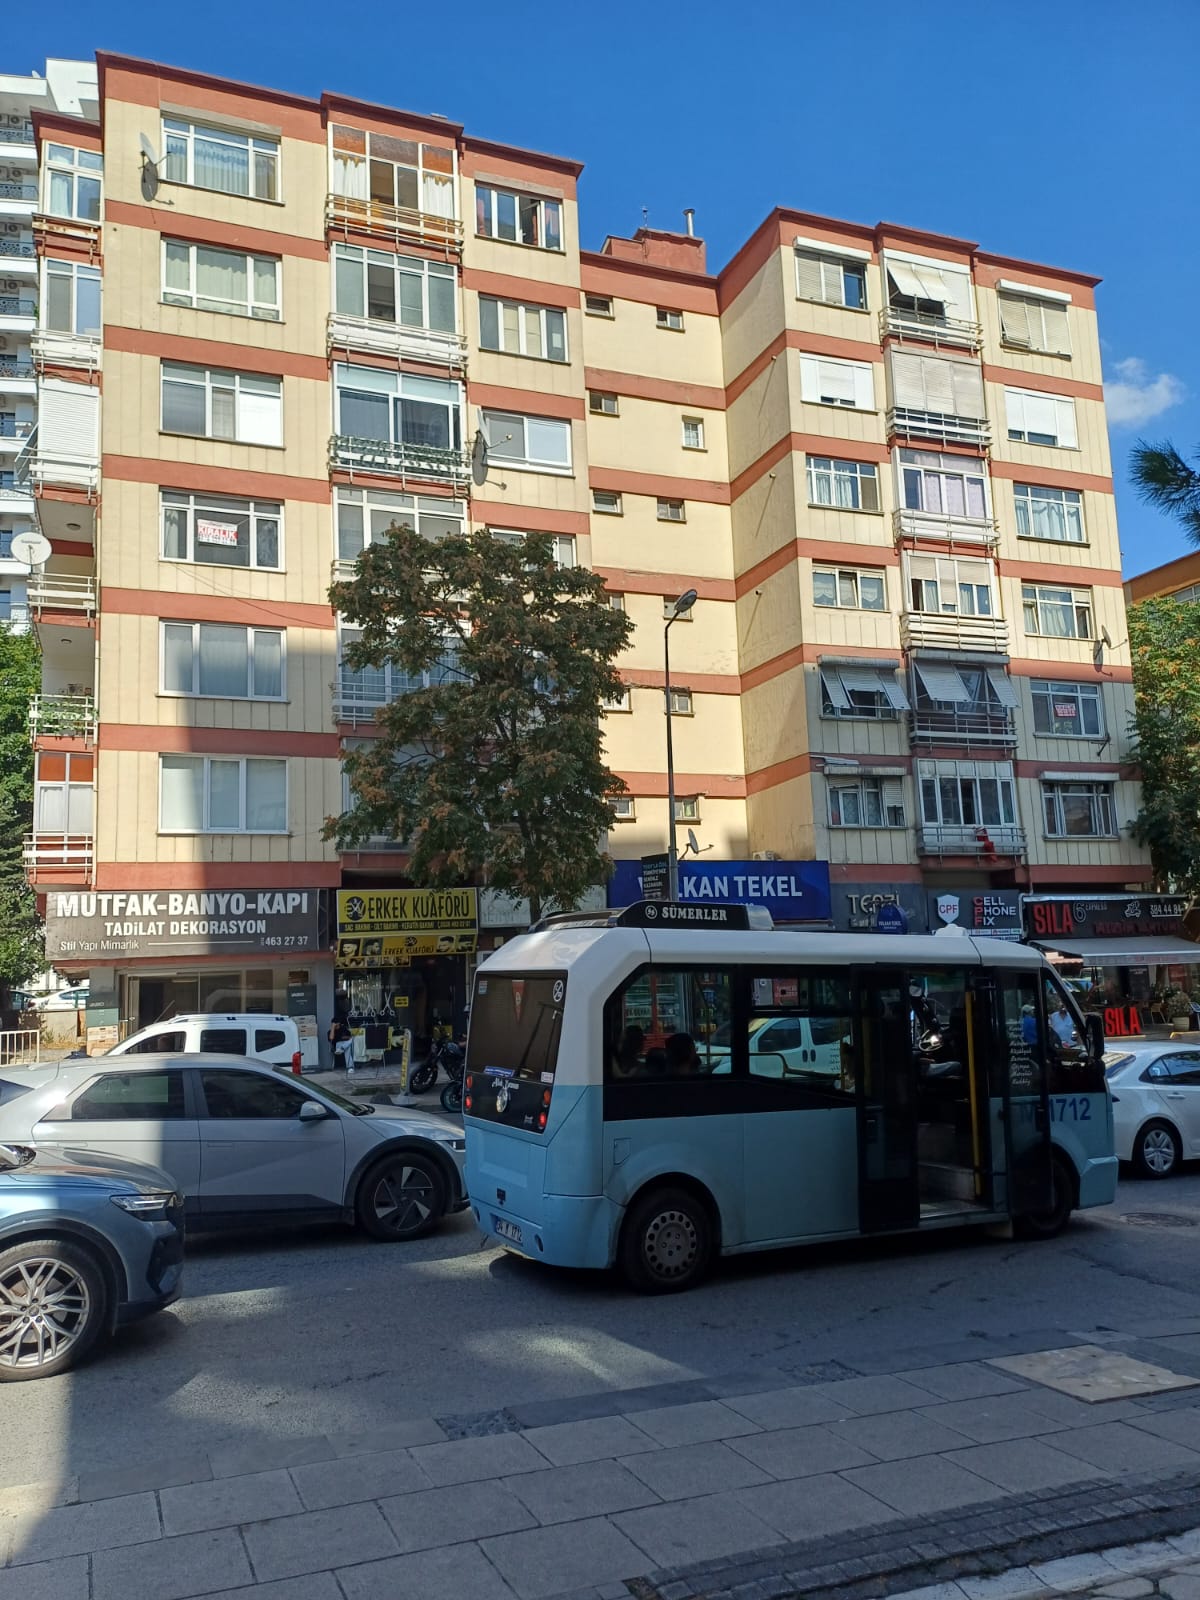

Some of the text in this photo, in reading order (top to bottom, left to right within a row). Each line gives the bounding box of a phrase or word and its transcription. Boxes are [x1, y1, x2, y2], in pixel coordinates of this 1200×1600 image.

[733, 875, 803, 897] TEKEL
[56, 892, 309, 918] MUTFAK-BANYO-KAPI
[367, 896, 408, 919] ERKEK
[413, 891, 470, 918] KUAFÖRÜ
[939, 904, 959, 914] CPF
[973, 896, 1005, 906] CELL
[661, 905, 728, 921] SÜMERLER
[973, 906, 1017, 916] PHONE
[1033, 903, 1074, 935] SILA
[170, 920, 267, 936] DEKORASYON
[973, 916, 995, 926] FIX
[265, 937, 281, 946] 463
[283, 937, 295, 946] 27
[297, 936, 309, 945] 37
[1104, 1007, 1141, 1036] SILA
